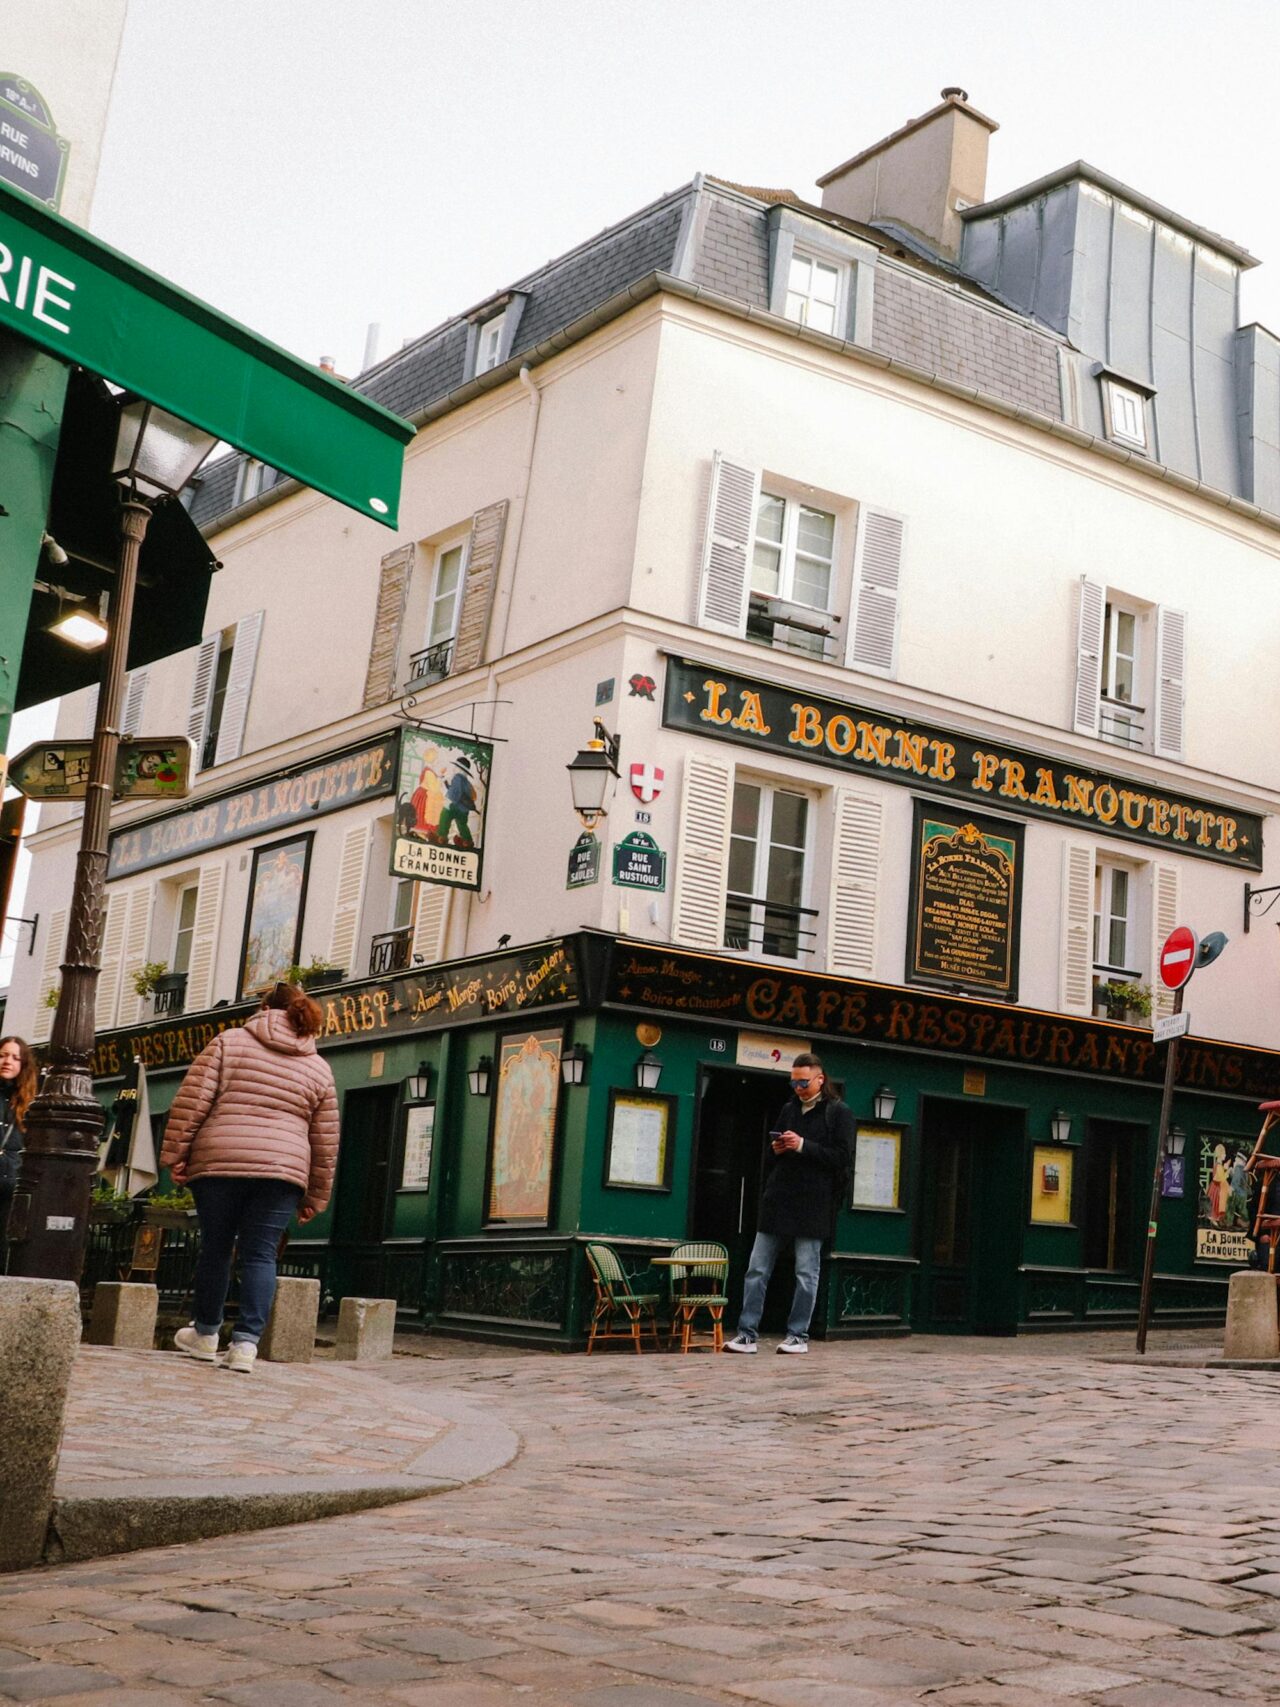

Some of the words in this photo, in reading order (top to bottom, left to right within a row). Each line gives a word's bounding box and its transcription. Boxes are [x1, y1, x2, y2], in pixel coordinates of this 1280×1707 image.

[1, 122, 28, 149] RUE
[0, 143, 39, 178] RVINS
[699, 679, 771, 735] LA
[788, 703, 956, 782] BONNE
[971, 749, 1238, 853] FRANQUETTE
[115, 832, 142, 868] LA
[150, 805, 218, 854] BONNE
[224, 748, 385, 834] FRANQUETTE
[636, 812, 650, 823] 18
[407, 844, 424, 858] LA
[428, 847, 467, 866] BONNE
[577, 851, 592, 863] RUE
[632, 852, 648, 863] RUE
[398, 855, 474, 881] FRANQUETTE
[570, 868, 594, 882] SAULES
[619, 870, 660, 886] RUSTIQUE
[628, 862, 652, 874] SAINT
[486, 980, 516, 1010] Boire
[516, 986, 528, 1005] et
[641, 986, 674, 1006] Boire
[315, 990, 388, 1040] ARET
[747, 977, 866, 1034] CAFÉ
[885, 1000, 1155, 1077] RESTAURANT
[89, 1040, 120, 1075] AFÉ
[129, 1017, 249, 1067] RESTAUR
[712, 1040, 722, 1050] 18
[1206, 1231, 1217, 1245] LA
[1220, 1233, 1247, 1246] BONNE
